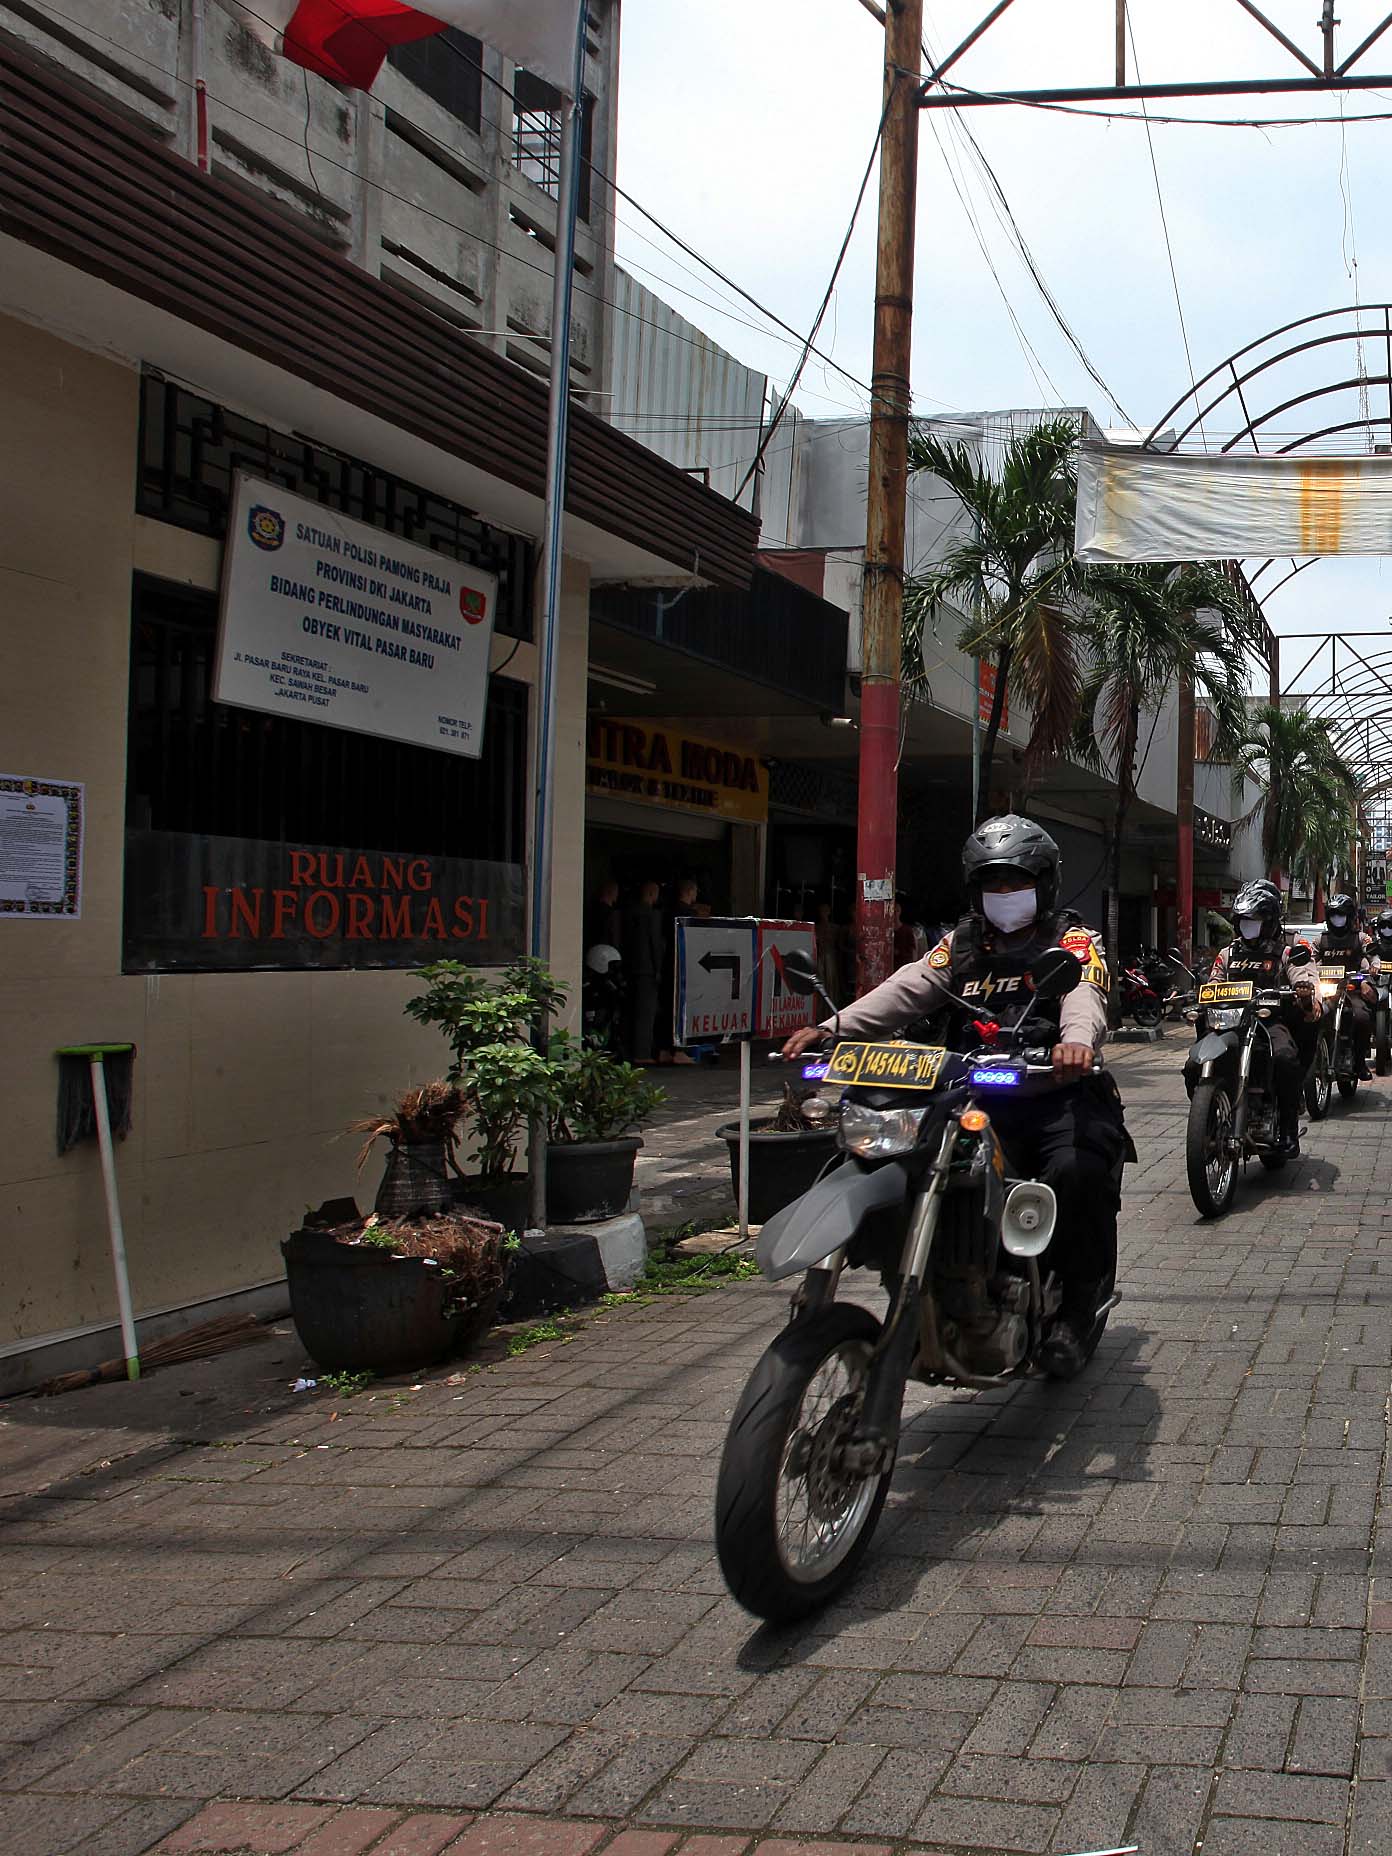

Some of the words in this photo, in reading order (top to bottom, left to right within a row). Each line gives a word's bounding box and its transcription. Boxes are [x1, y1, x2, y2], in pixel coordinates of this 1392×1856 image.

[296, 523, 341, 554] SATUAN
[343, 542, 376, 567] POLISI
[379, 554, 420, 583] PAMONG
[423, 571, 451, 596] PRAJA
[316, 560, 367, 592] PROVINSI
[369, 582, 386, 596] DKI
[389, 588, 432, 615] JAKARTA
[270, 575, 314, 603] BIDANG
[318, 593, 399, 631] PERLINDUNGAN
[402, 620, 461, 651] MASYARAKAT
[281, 651, 328, 671] SEKRETARIAT
[303, 616, 340, 642] OBYEK
[343, 629, 373, 651] VITAL
[376, 640, 406, 661] PASAR
[410, 651, 434, 669] BARU
[244, 654, 270, 669] PASAR
[271, 662, 291, 674] BARU
[293, 667, 311, 680] RAYA
[328, 675, 350, 689] PASAR
[351, 681, 369, 693] BARU
[288, 678, 312, 691] SAWAH
[314, 684, 336, 697] BESAR
[308, 694, 329, 707] PUSAT
[681, 740, 759, 793] MODA
[289, 850, 432, 891] RUANG
[201, 885, 489, 940] INFORMASI
[692, 1012, 748, 1032] KELUAR
